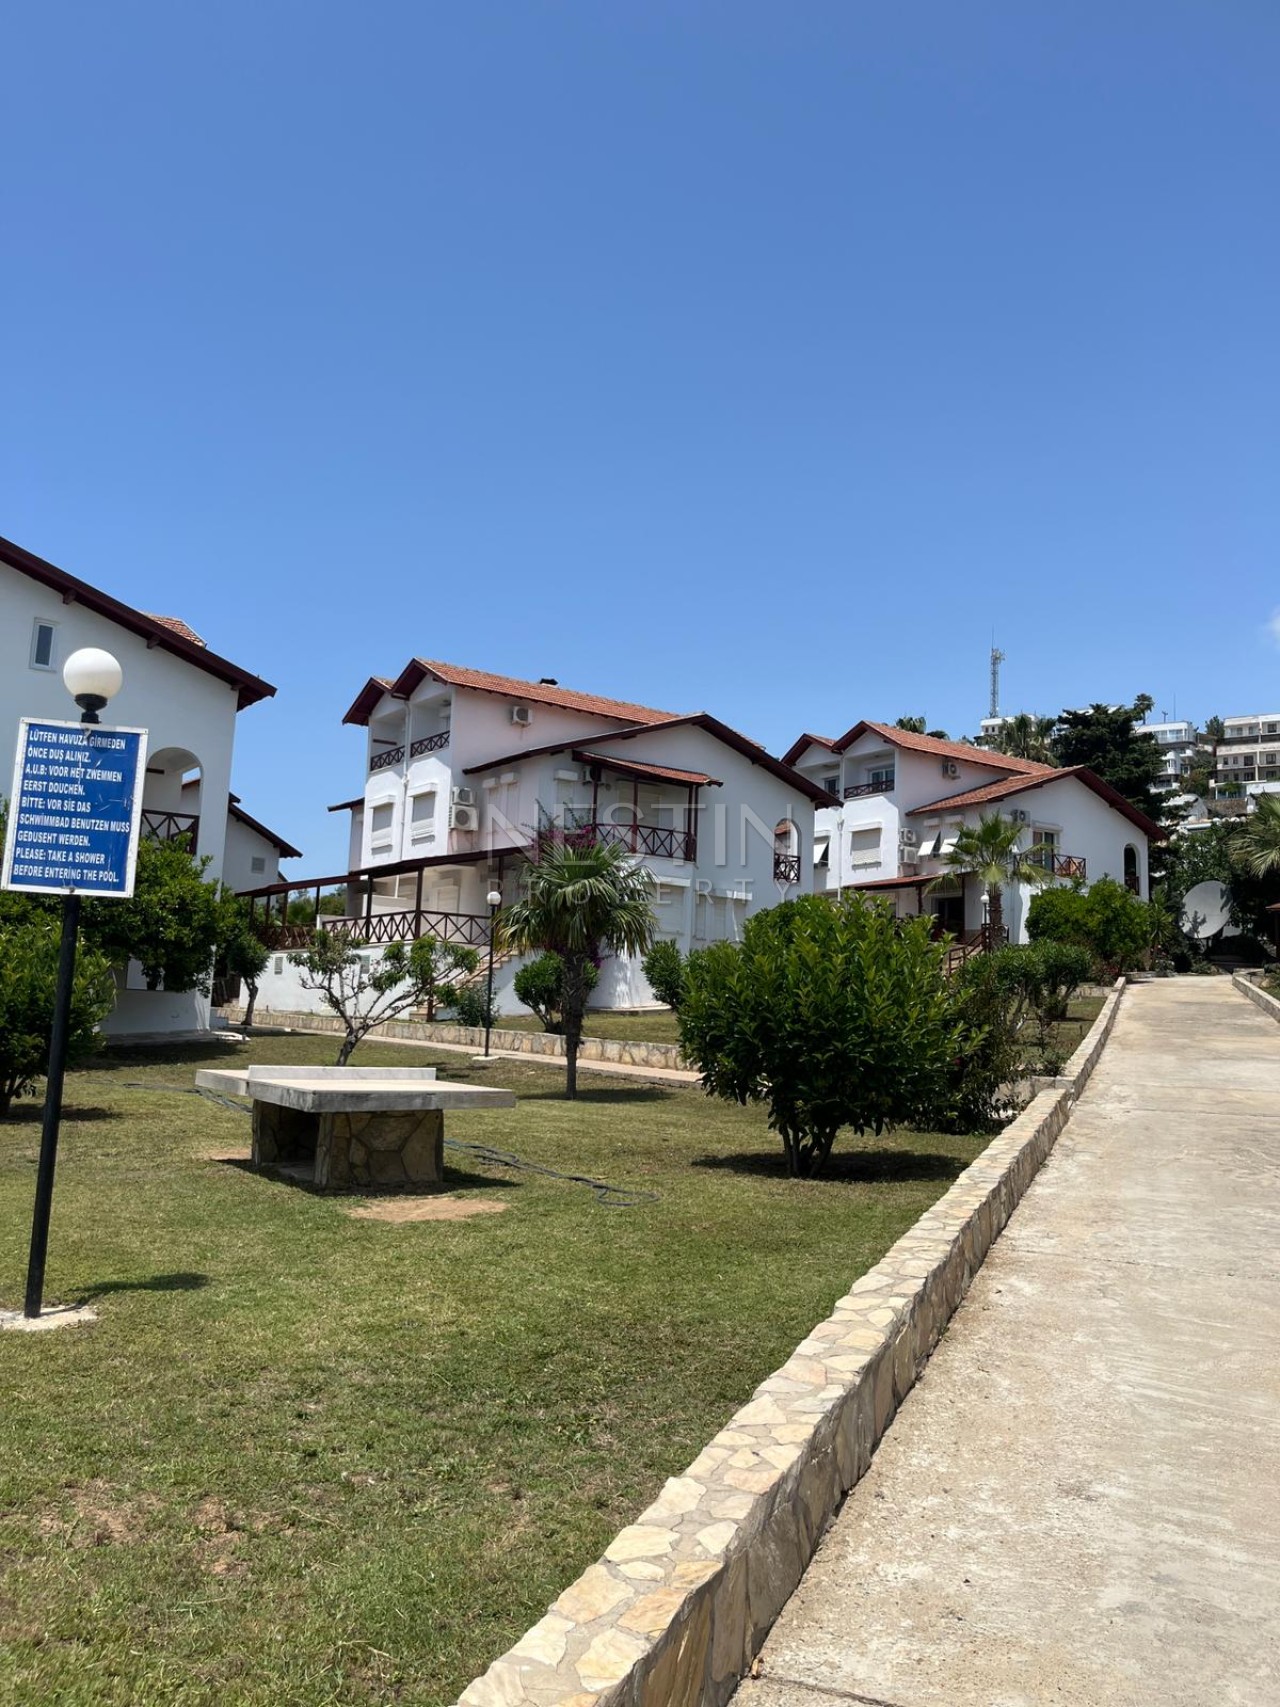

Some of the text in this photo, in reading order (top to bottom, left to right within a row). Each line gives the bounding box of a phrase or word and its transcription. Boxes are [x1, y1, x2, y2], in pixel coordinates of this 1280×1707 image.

[29, 729, 126, 750] LÜTFEN HAVUZA GİRMEDEN
[27, 745, 92, 763] ÖNCE DUŞ ALINIZ.
[49, 765, 69, 777] VOOR
[69, 767, 84, 779] HET
[85, 769, 123, 782] ZWEMMEN
[23, 780, 86, 796] EERST DOUCHEN.
[47, 798, 62, 810] VOR
[76, 801, 92, 813] DAS
[71, 817, 109, 831] BENUTZEN
[110, 820, 131, 833] MUSS
[58, 833, 91, 847] WERDEN.
[15, 847, 105, 865] PLEASE: TAKE A SHOWER
[13, 864, 44, 877] BEFORE
[82, 869, 97, 881] THE
[98, 871, 120, 883] POOL.
